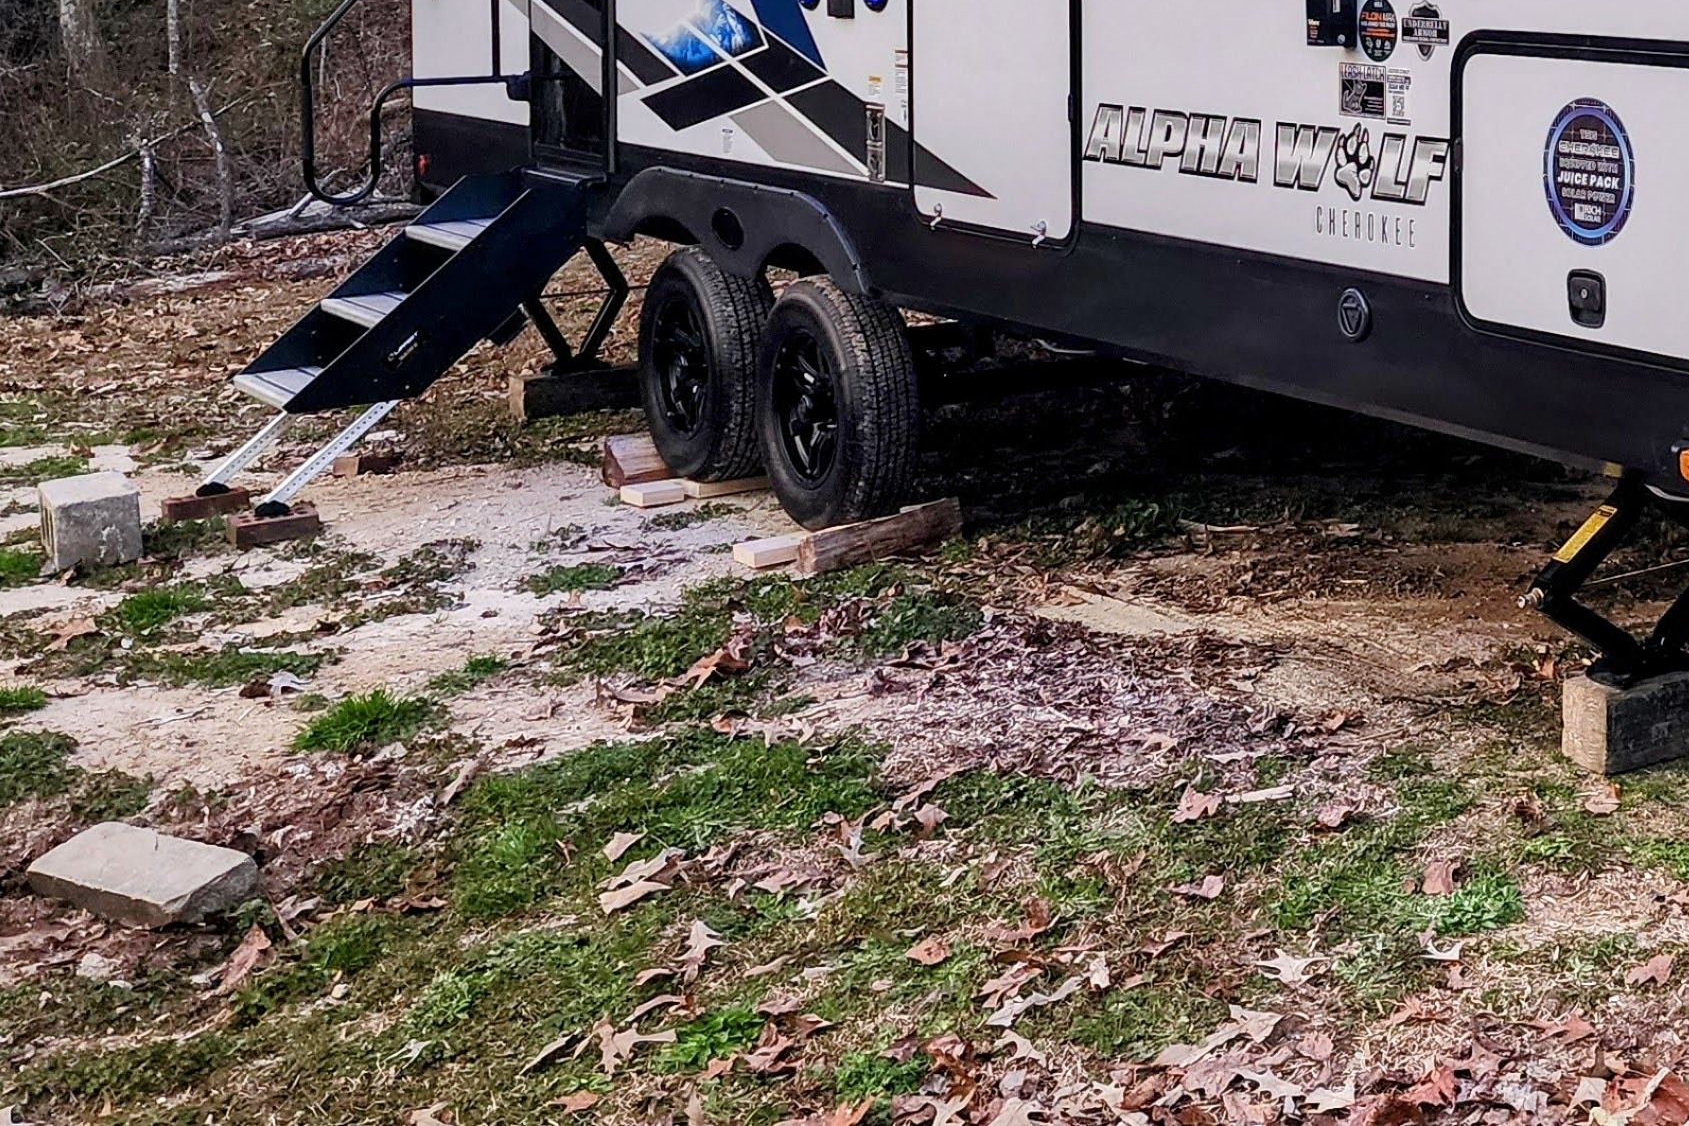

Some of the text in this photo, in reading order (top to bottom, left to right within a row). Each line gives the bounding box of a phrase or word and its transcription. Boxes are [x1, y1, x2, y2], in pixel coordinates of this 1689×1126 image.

[1083, 103, 1262, 184] ALPHA
[1557, 170, 1620, 189] JUICE PACK
[1316, 206, 1415, 248] CHEROKEE
